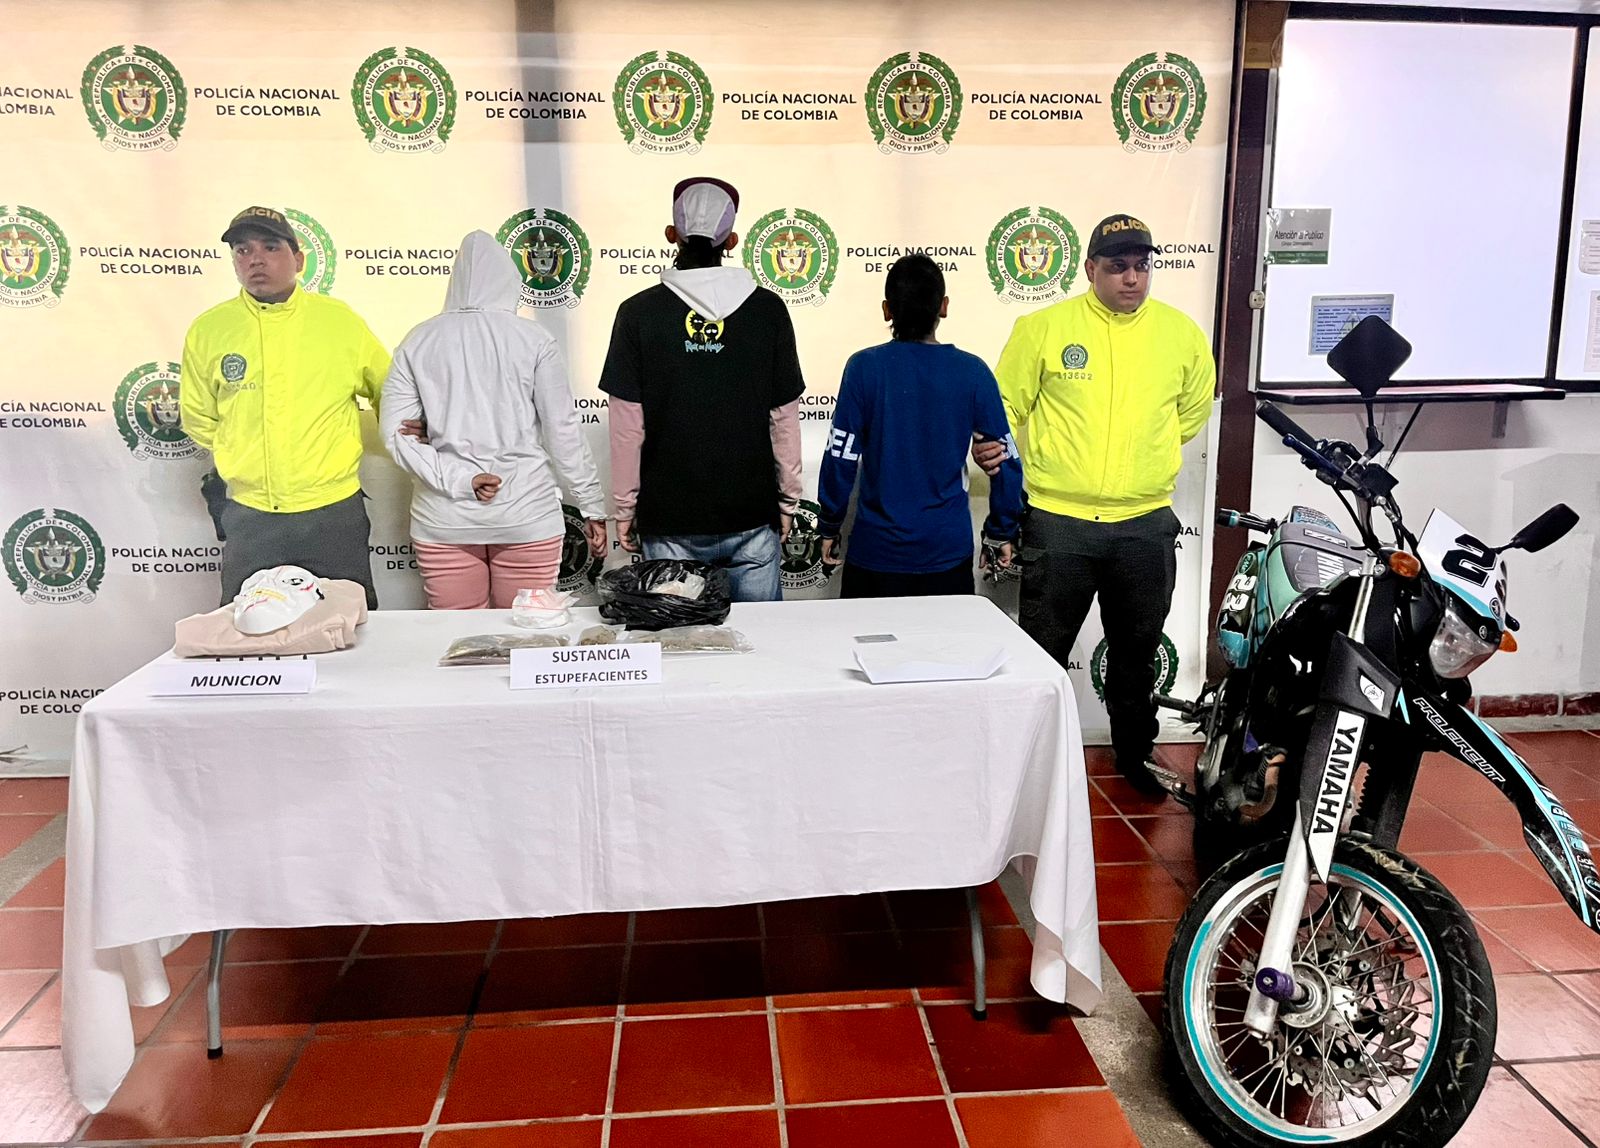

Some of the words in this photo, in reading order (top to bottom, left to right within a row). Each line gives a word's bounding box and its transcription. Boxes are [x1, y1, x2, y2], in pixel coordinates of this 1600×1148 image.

[145, 61, 174, 104] COLOMBIA
[417, 64, 444, 107] COLOMBIA
[677, 67, 702, 109] COLOMBIA
[928, 68, 951, 109] COLOMBIA
[0, 86, 74, 99] ACIONAL
[195, 86, 255, 98] POLICÍA
[260, 89, 339, 99] NACIONAL
[465, 89, 523, 102] POLICÍA
[527, 91, 606, 103] NACIONAL
[723, 91, 778, 103] POLICÍA
[783, 94, 856, 104] NACIONAL
[972, 91, 1025, 103] POLICÍA
[1030, 94, 1102, 103] NACIONAL
[0, 103, 55, 116] LOMBIA
[217, 105, 235, 115] DE
[241, 106, 320, 116] COLOMBIA
[485, 108, 506, 119] DE
[508, 108, 587, 119] COLOMBIA
[742, 110, 759, 120] DE
[764, 110, 837, 120] COLOMBIA
[990, 110, 1006, 119] DE
[1011, 110, 1083, 120] COLOMBIA
[138, 113, 172, 139] NACIONAL
[408, 116, 442, 141] NACIONAL
[665, 118, 699, 142] NACIONAL
[914, 118, 948, 142] NACIONAL
[506, 223, 528, 249] UBLICA
[555, 224, 580, 264] COLOMBIA
[1047, 222, 1069, 261] COLOMBIA
[80, 245, 134, 257] POLICÍA
[140, 248, 221, 258] NACIONAL
[346, 247, 403, 259] POLICÍA
[407, 249, 456, 259] NACIO
[600, 246, 656, 259] POLICÍA
[847, 244, 900, 257] POLICÍA
[1155, 244, 1215, 253] ACIONAL
[101, 264, 117, 273] DE
[121, 264, 202, 274] COLOMBIA
[366, 266, 384, 275] DE
[389, 265, 451, 275] COLOMB
[620, 265, 637, 274] DE
[865, 263, 882, 272] DE
[1154, 260, 1195, 269] OMBIA
[544, 273, 577, 297] NACIONAL
[791, 272, 824, 295] NACIONAL
[1032, 269, 1066, 292] NACIONAL
[30, 402, 105, 412] NACIONAL
[12, 418, 86, 428] COLOMBIA
[65, 523, 94, 561] COLOMBIA
[112, 546, 167, 557] POLICÍA
[172, 547, 220, 557] NACIO
[369, 543, 416, 555] POLICÍ
[132, 563, 149, 572] DE
[154, 563, 221, 572] COLOMBI
[387, 560, 405, 570] DE
[57, 570, 92, 593] NACIONAL
[552, 648, 631, 663] SUSTANCIA
[190, 675, 282, 687] MUNICION
[535, 669, 648, 685] ESTUPEFACIENTES
[0, 687, 57, 700] POLICÍA
[20, 704, 39, 714] DE
[43, 703, 82, 713] COLO
[1312, 726, 1358, 834] YAMAHA
